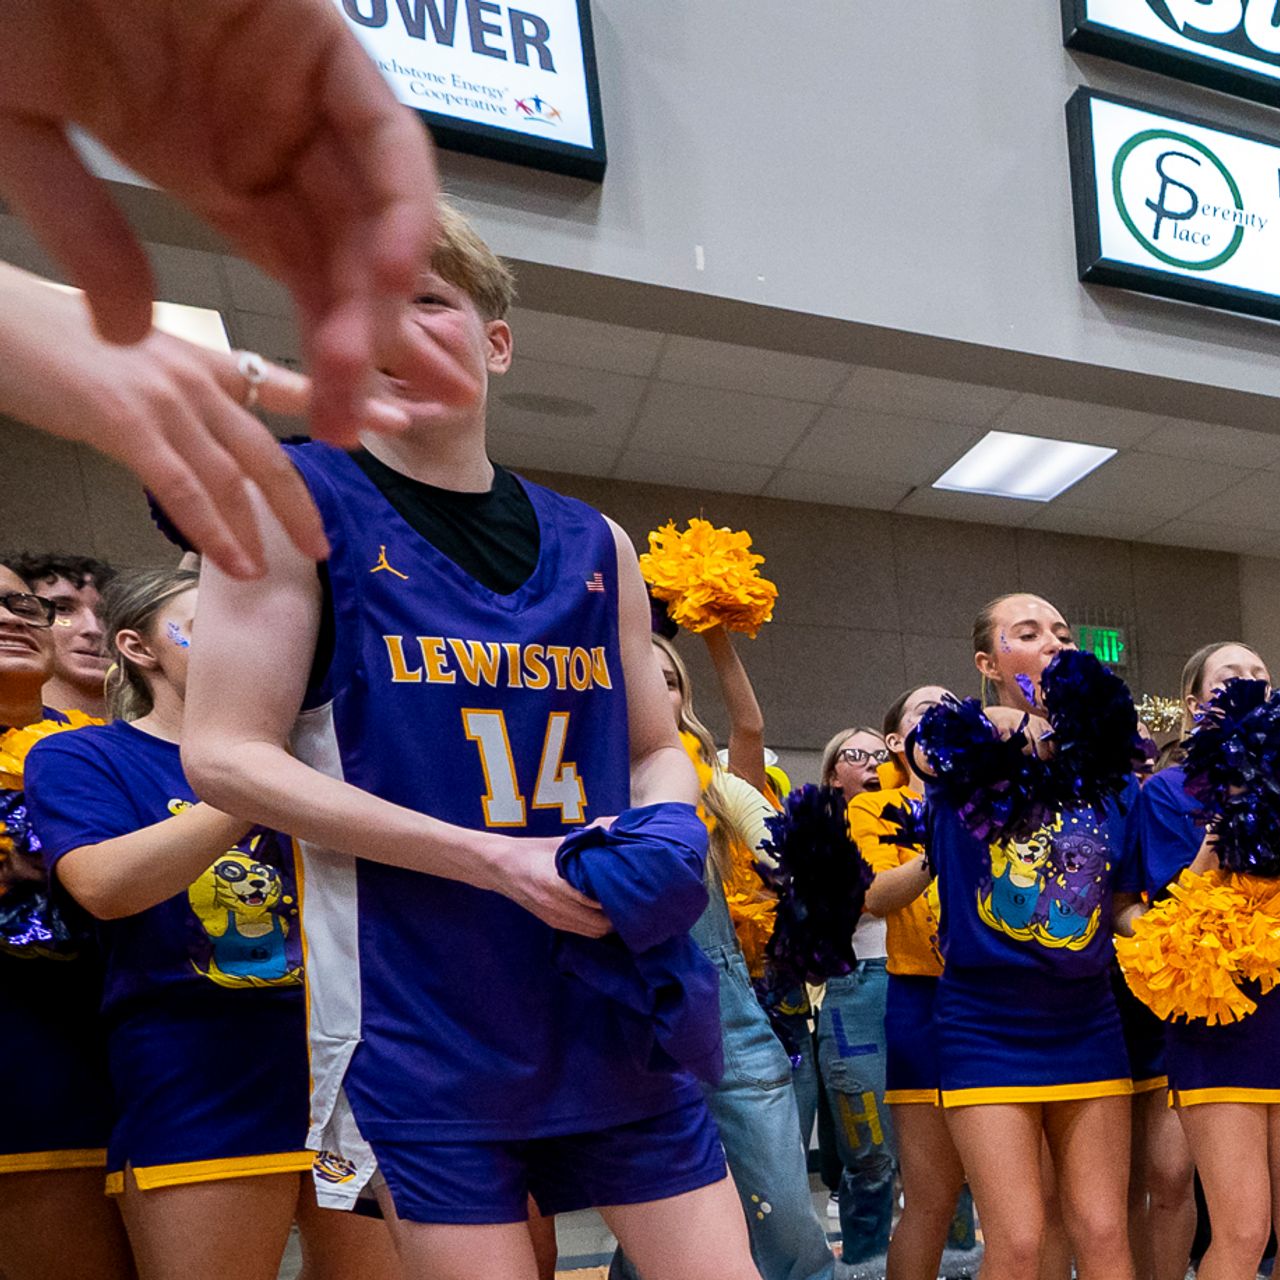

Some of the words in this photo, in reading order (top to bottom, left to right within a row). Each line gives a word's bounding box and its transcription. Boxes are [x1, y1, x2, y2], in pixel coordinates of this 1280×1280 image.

[410, 81, 508, 115] Cooperative
[451, 73, 505, 99] Energy
[382, 635, 613, 691] LEWISTON
[460, 707, 588, 828] 14
